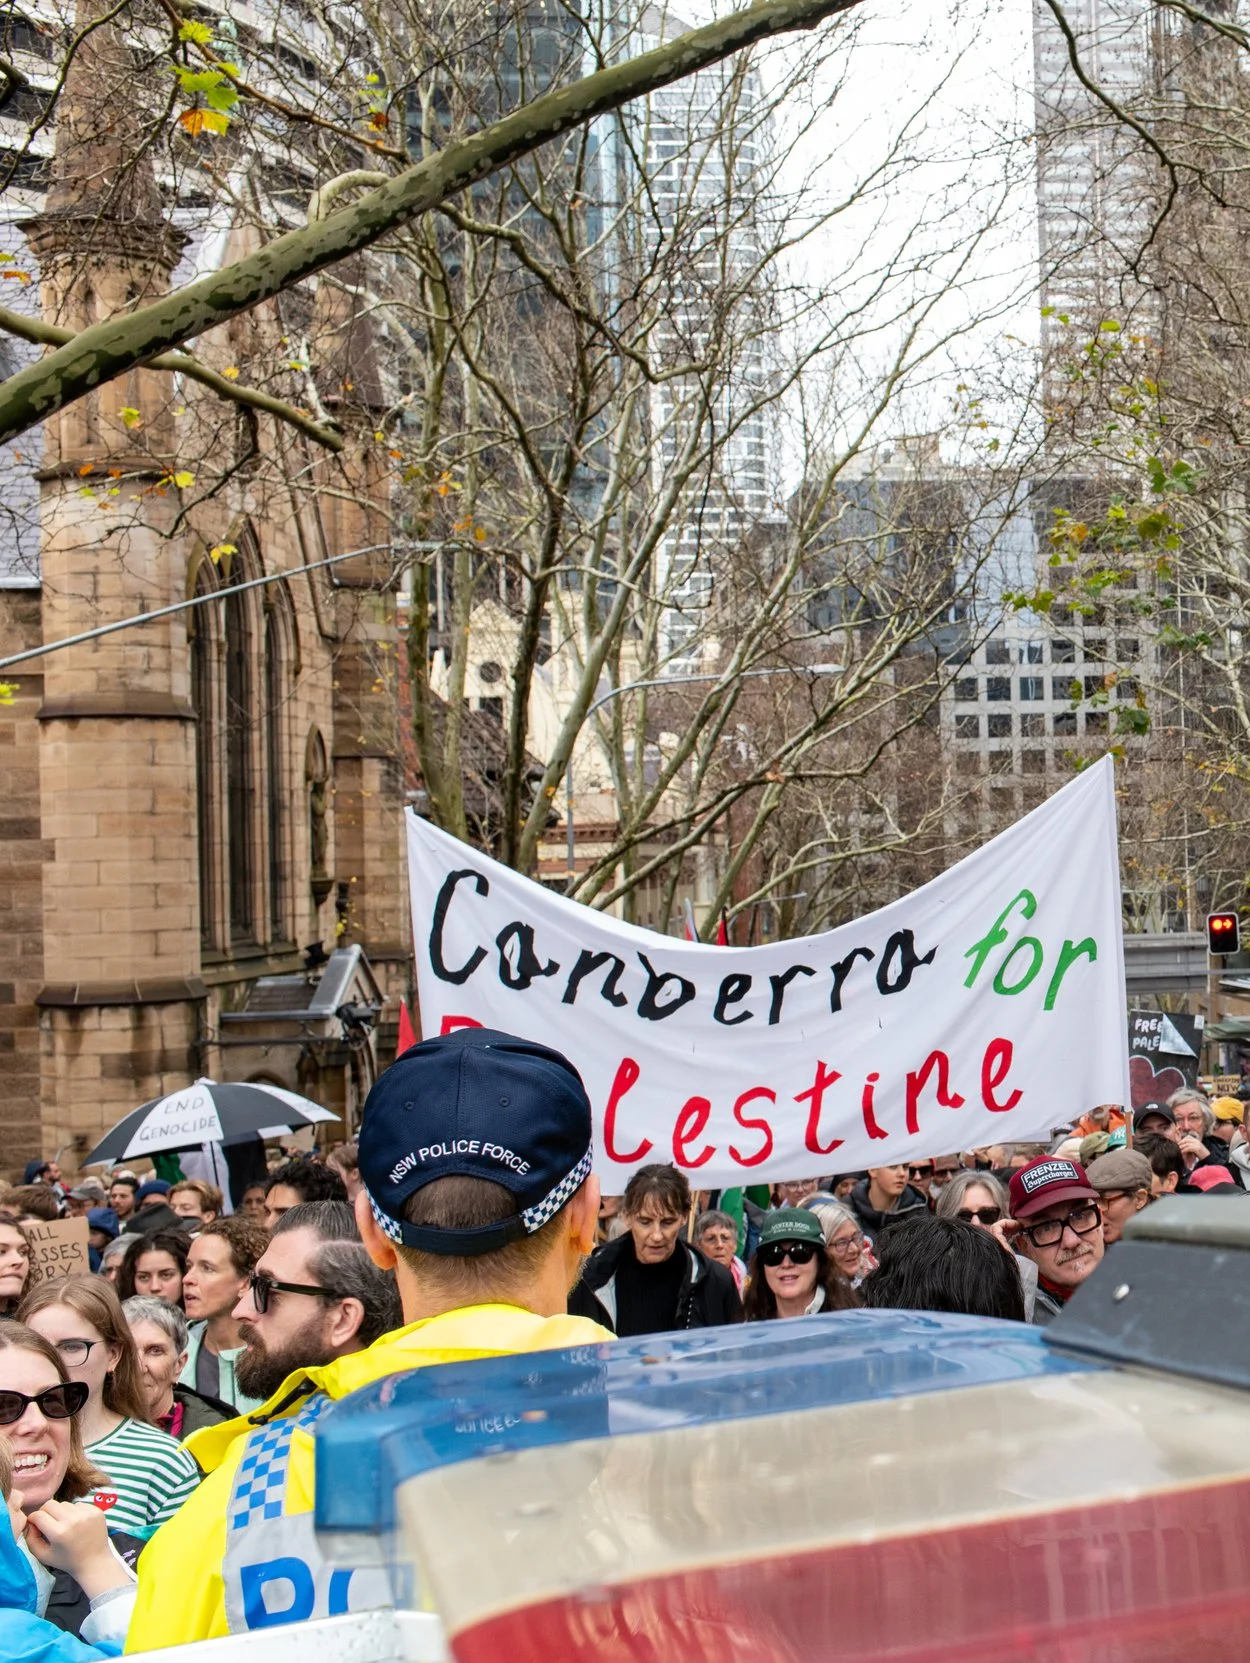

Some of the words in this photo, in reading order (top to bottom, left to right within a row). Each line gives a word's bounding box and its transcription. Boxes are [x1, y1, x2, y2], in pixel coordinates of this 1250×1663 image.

[428, 868, 938, 1026] Canberra
[963, 889, 1098, 1011] for
[1135, 1018, 1163, 1032] FREE
[440, 1015, 1024, 1168] lestine
[164, 1096, 205, 1115] END
[138, 1115, 217, 1142] GENOCIDE
[389, 1152, 417, 1184] NSW
[418, 1140, 480, 1161] POLICE
[481, 1142, 531, 1176] FORCE
[1024, 1162, 1072, 1184] FRENZEL
[36, 1242, 84, 1263] SSES,
